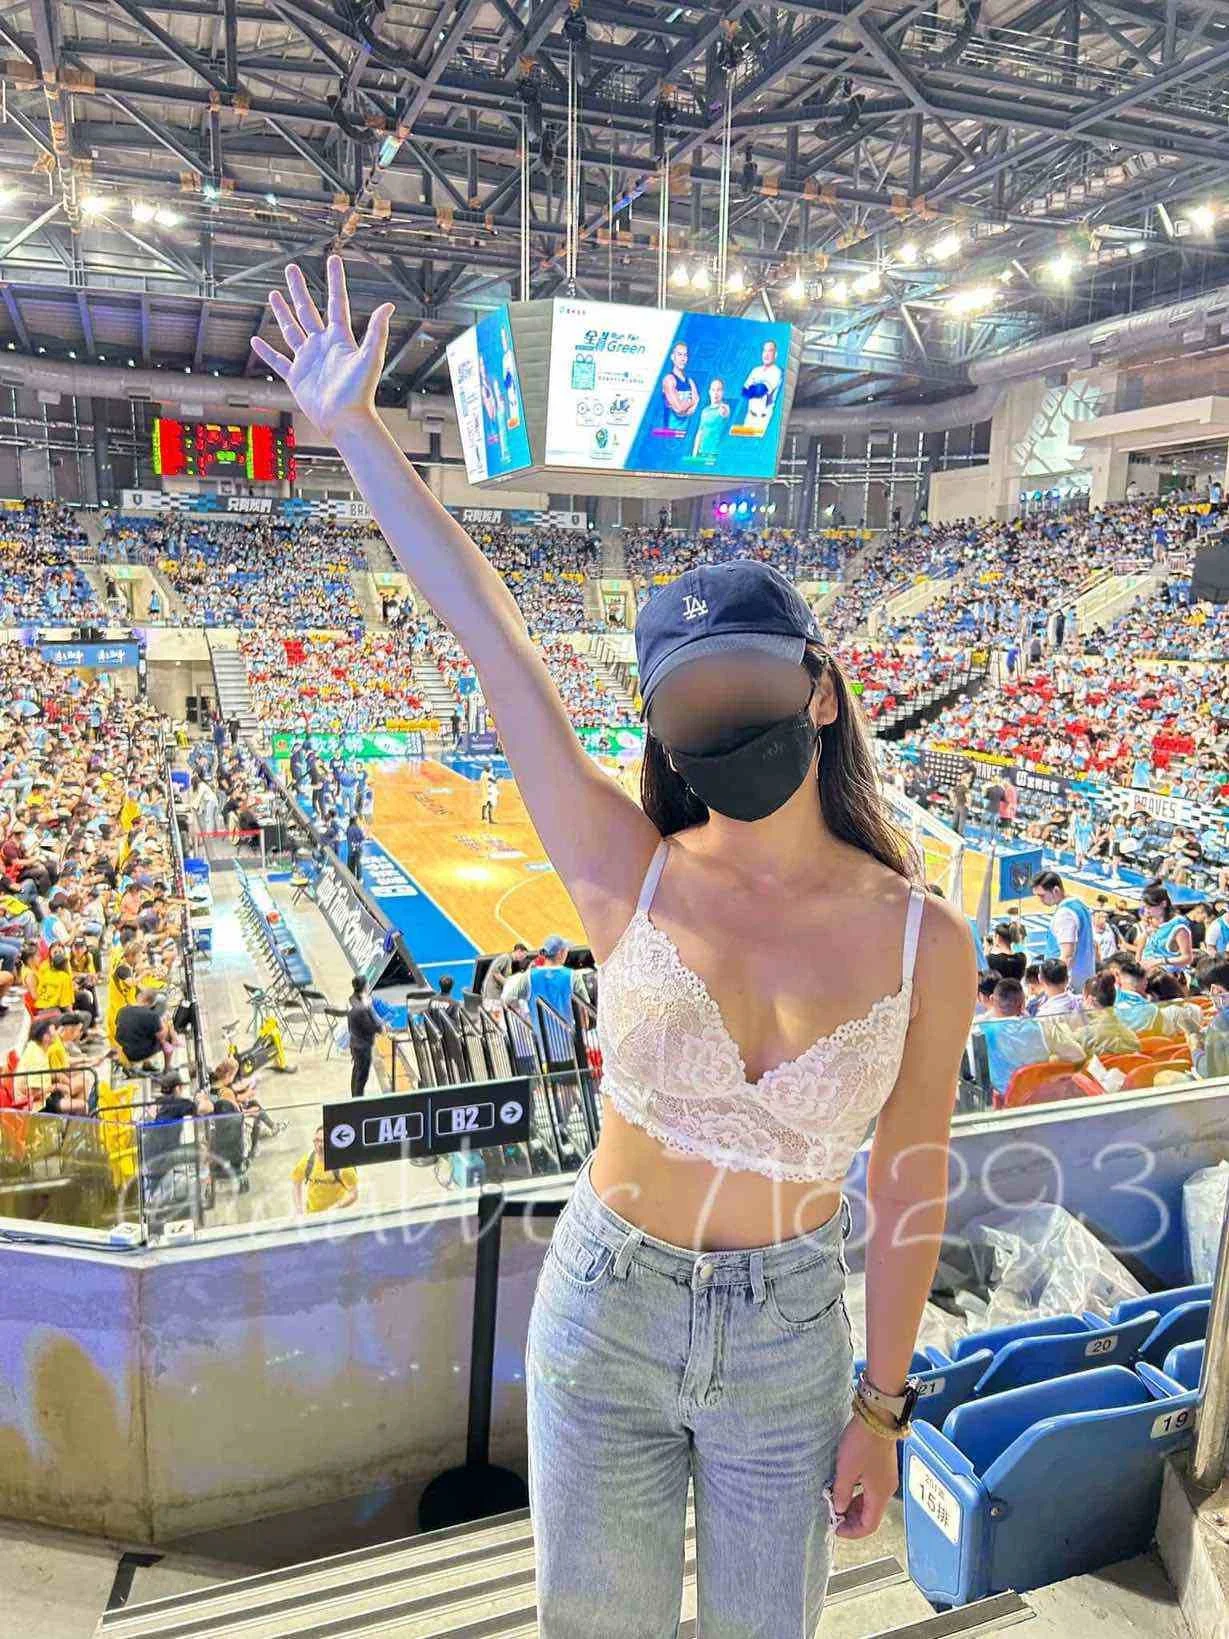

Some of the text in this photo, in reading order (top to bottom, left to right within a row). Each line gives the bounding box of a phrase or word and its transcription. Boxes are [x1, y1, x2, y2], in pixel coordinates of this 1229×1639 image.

[607, 340, 646, 354] Green
[682, 595, 709, 620] LA
[378, 1116, 408, 1142] A4
[451, 1106, 480, 1132] B2
[1093, 1339, 1112, 1353] 20
[1162, 1410, 1189, 1432] 19
